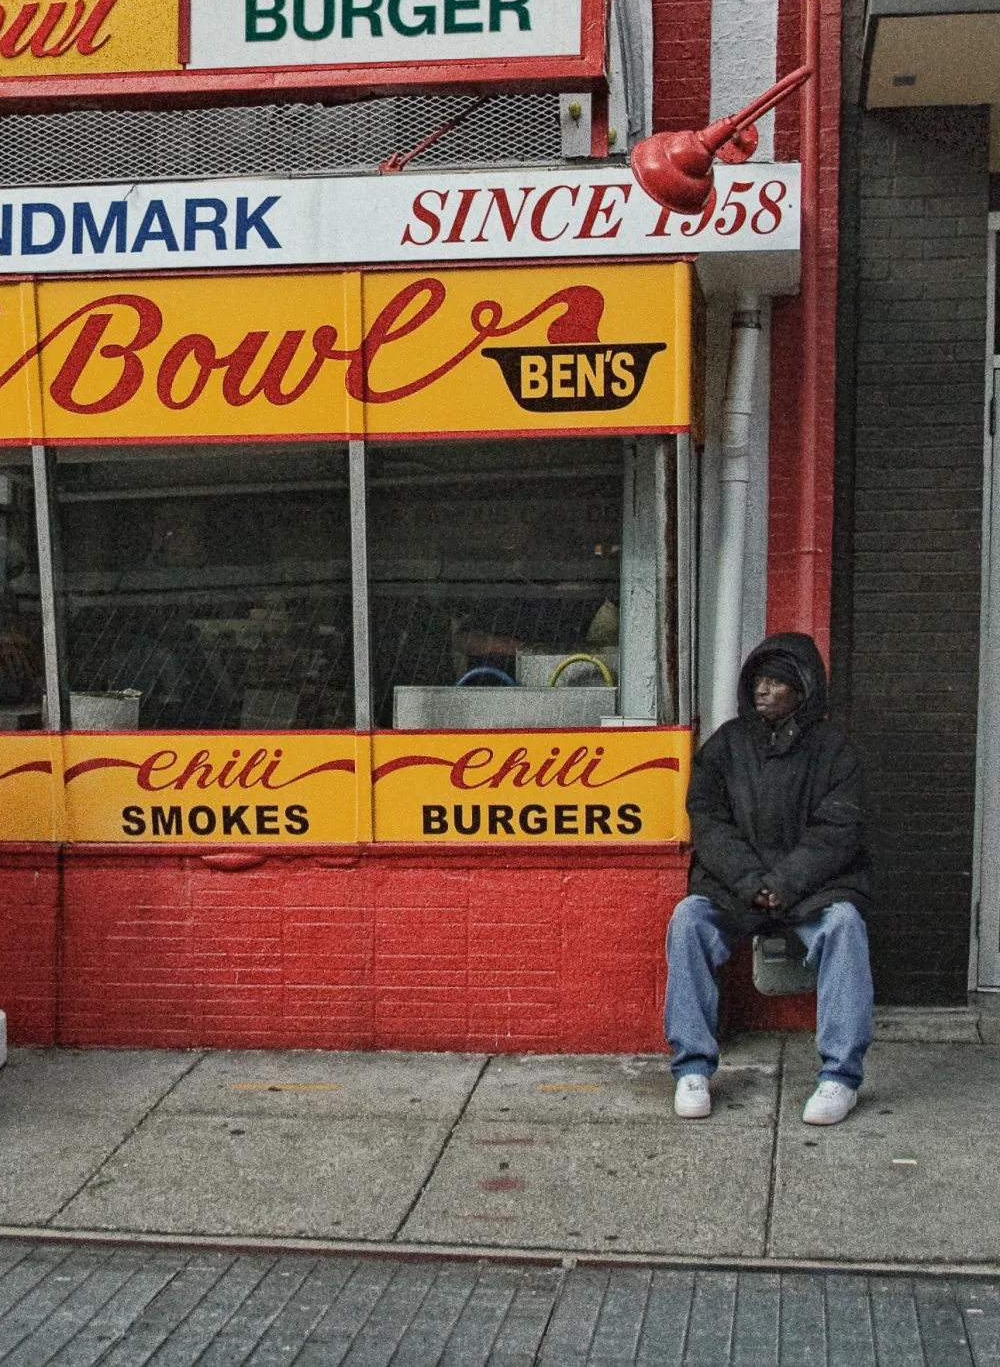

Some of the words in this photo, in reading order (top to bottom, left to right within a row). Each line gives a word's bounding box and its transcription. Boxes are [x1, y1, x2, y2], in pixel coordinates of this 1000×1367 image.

[400, 182, 633, 247] SINCE
[48, 277, 452, 415] Bowl
[519, 351, 635, 399] BEN'S
[135, 748, 287, 792] Chili
[450, 745, 610, 790] Chili
[121, 804, 310, 836] SMOKES
[422, 802, 643, 836] BURGERS
